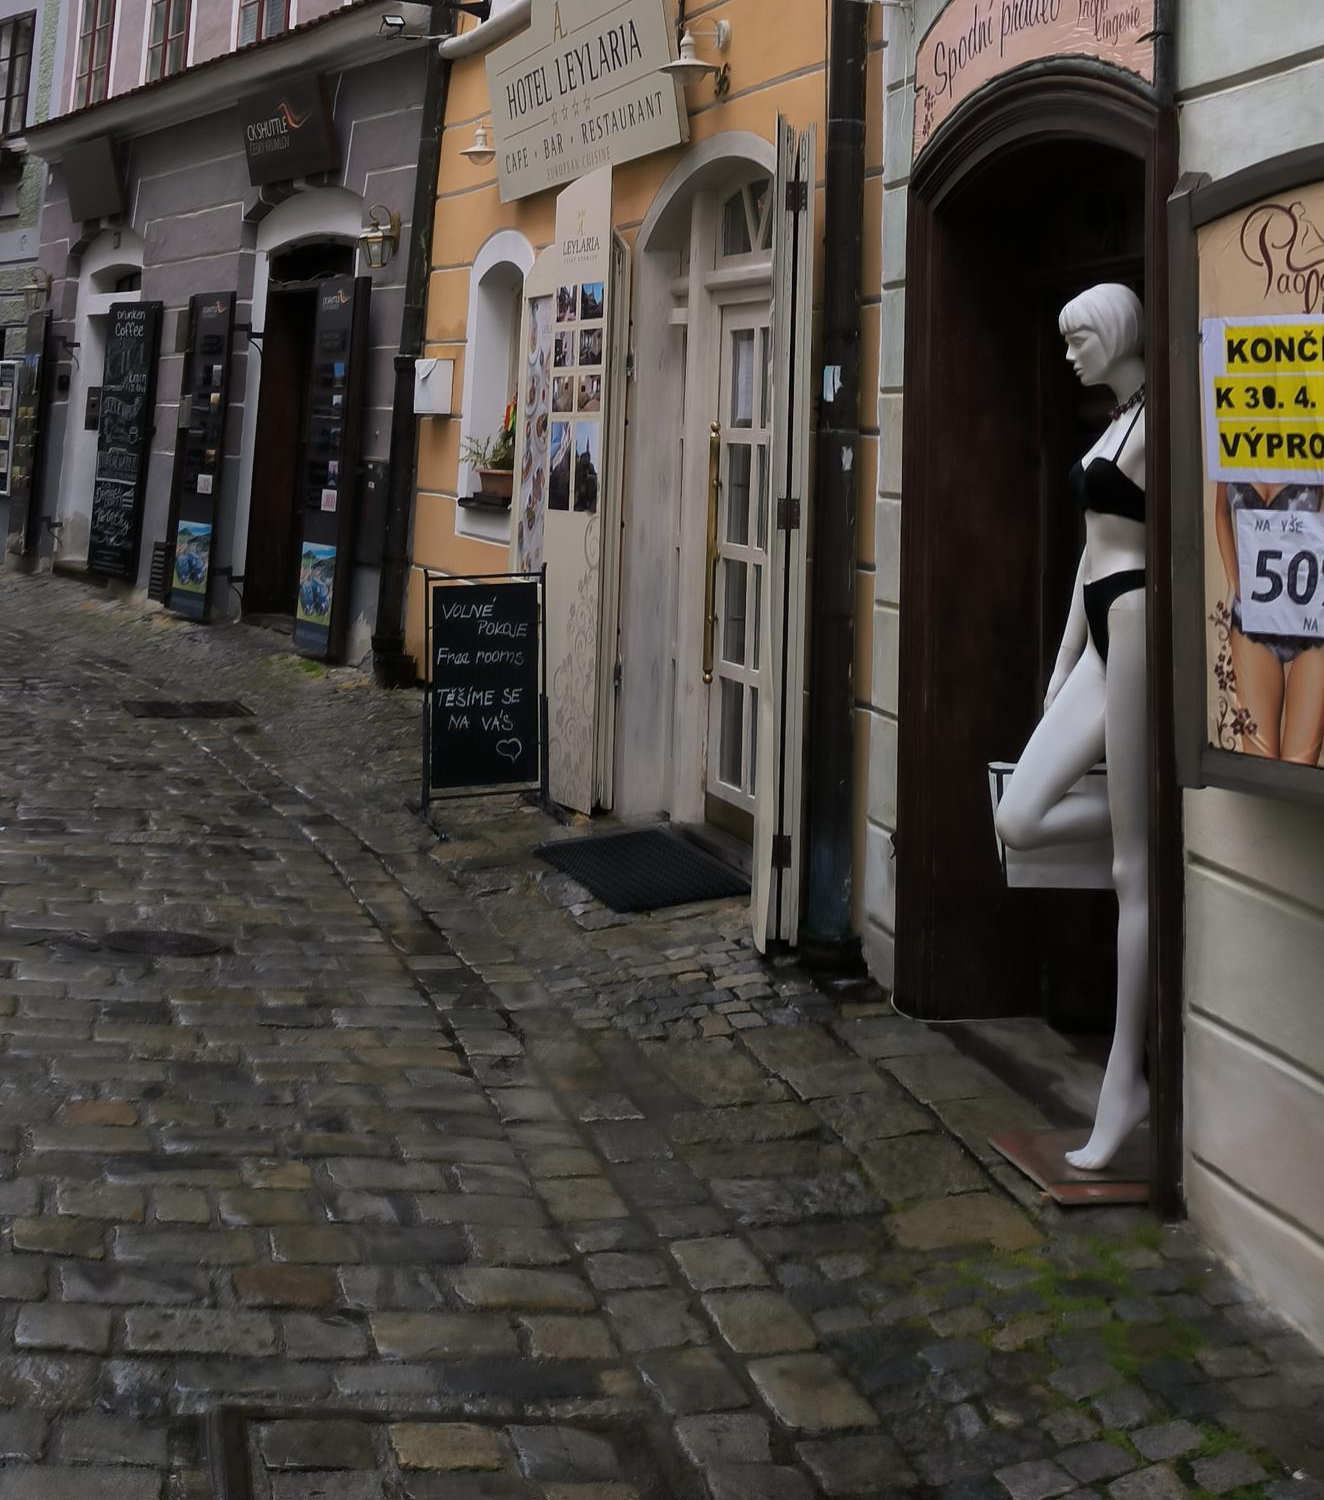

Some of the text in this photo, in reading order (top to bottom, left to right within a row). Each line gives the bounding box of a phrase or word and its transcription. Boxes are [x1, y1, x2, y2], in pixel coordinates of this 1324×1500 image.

[506, 19, 642, 120] HOTEL LEYLARIA
[505, 91, 664, 174] CAFE BAR RESTAURANT
[546, 146, 610, 181] EUROPEAN CUISINE
[562, 235, 600, 256] LEYLARIA
[1240, 202, 1324, 314] Paol
[1215, 387, 1235, 409] K
[1294, 385, 1317, 409] 4.
[1254, 518, 1271, 532] NA
[441, 596, 497, 620] VOLNÉ
[477, 620, 528, 637] POKOJE
[1303, 617, 1319, 632] NA
[475, 650, 525, 666] rooms
[437, 687, 524, 708] TĚŠÍME SE
[447, 709, 514, 732] NA VÁS
